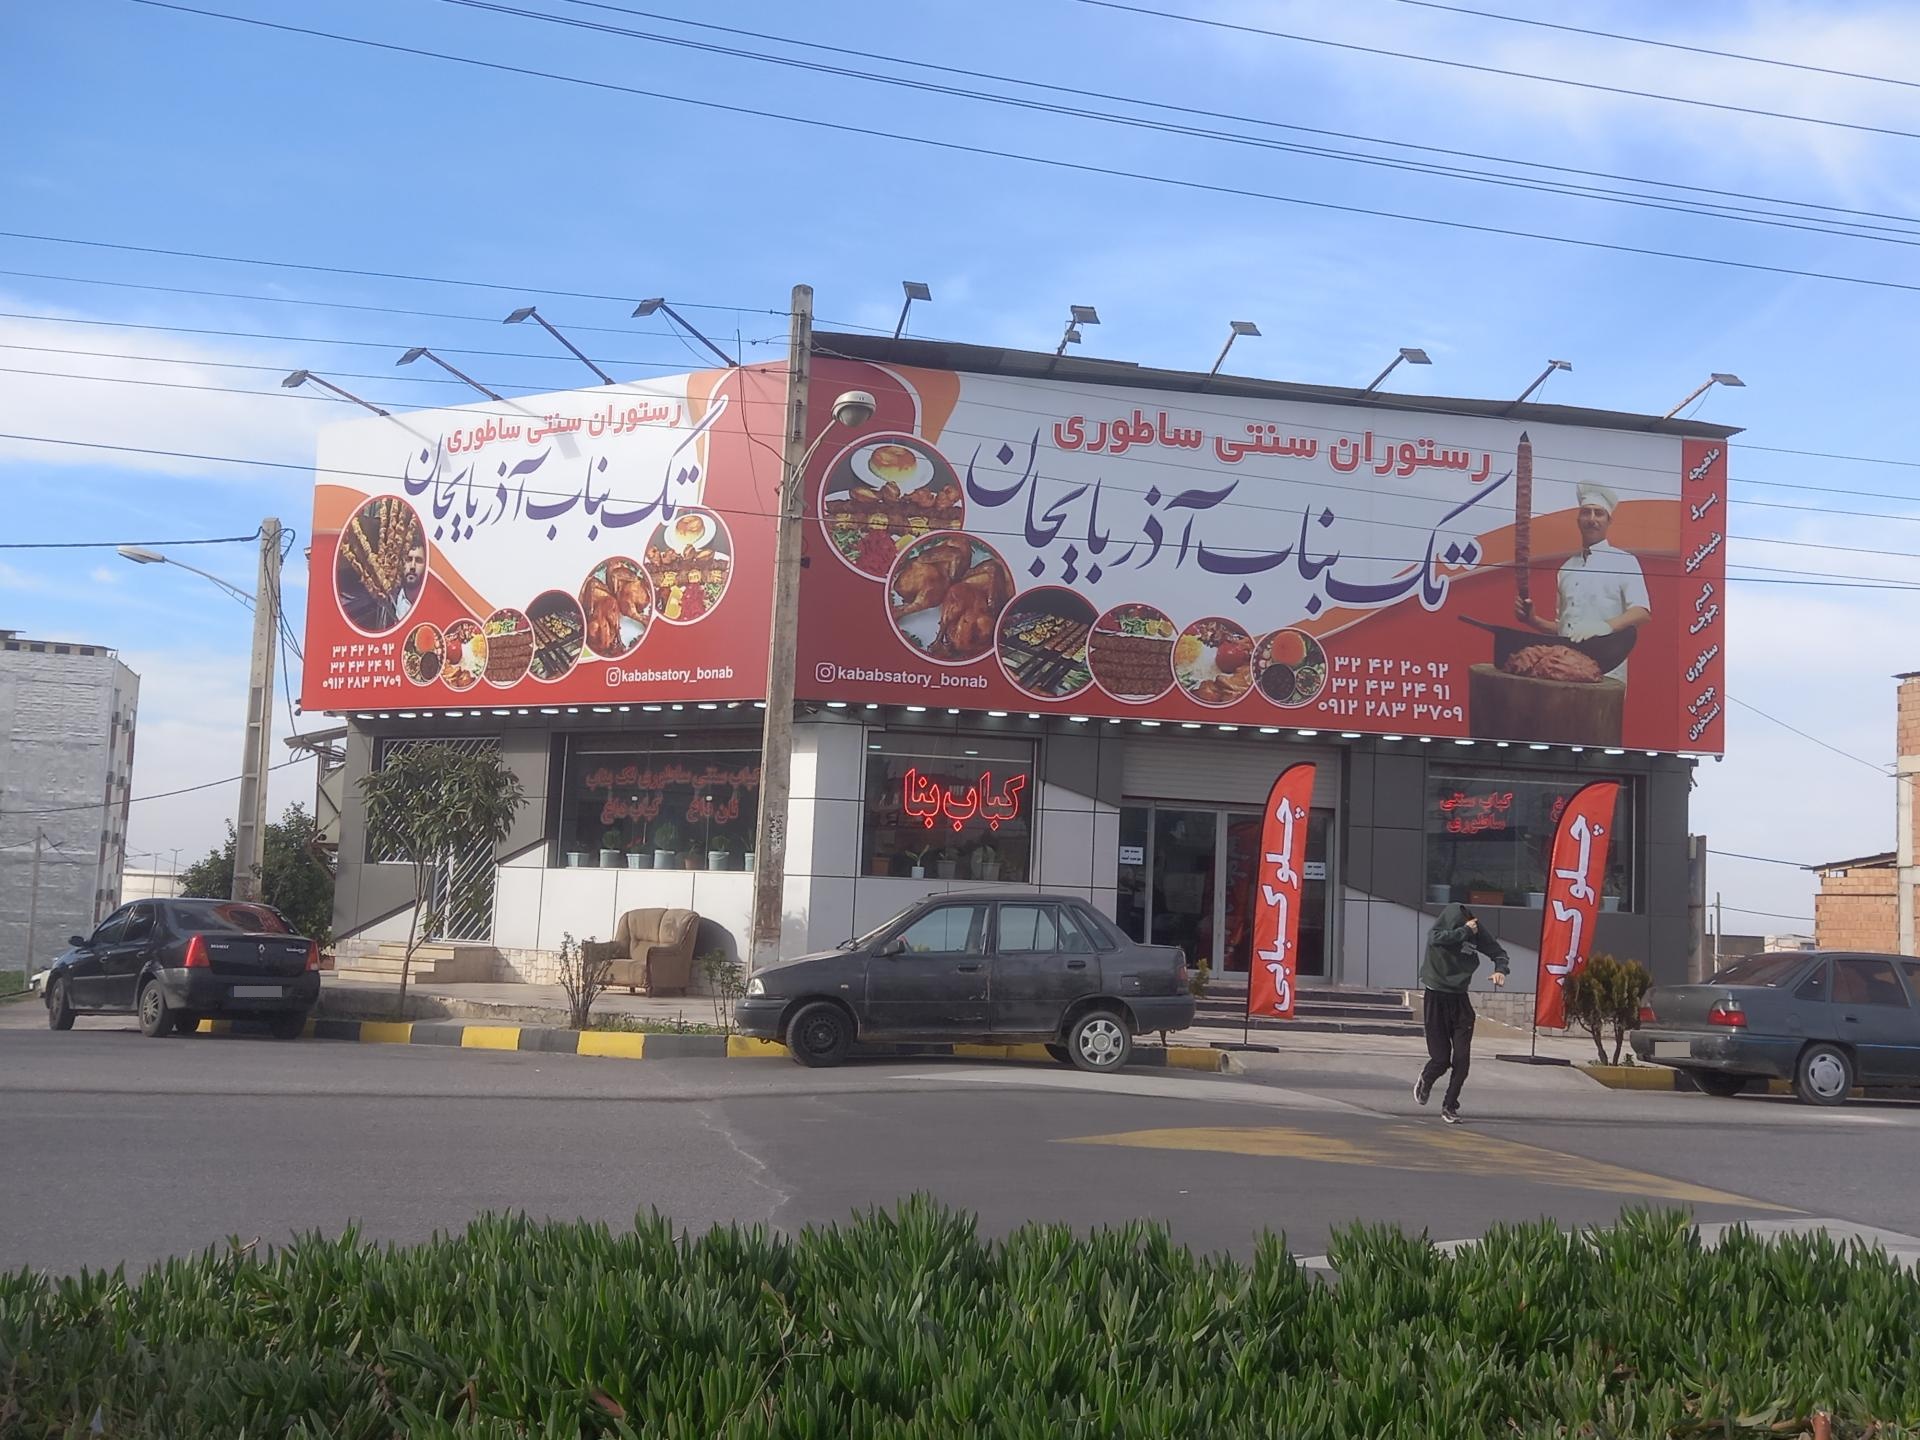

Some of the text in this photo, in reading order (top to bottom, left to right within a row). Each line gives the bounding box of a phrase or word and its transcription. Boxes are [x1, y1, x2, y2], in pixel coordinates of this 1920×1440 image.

[446, 402, 682, 454] رستوران سنتی ساطوری
[1052, 409, 1492, 483] رستوران سنتی ساطوری
[403, 397, 728, 542] تک بناب آذربایجان
[1689, 448, 1720, 481] ماهیچه
[966, 427, 1513, 614] تک بناب آذربایجان
[1691, 492, 1719, 521] برگ
[1685, 531, 1722, 573] شیشلیک
[1696, 583, 1714, 611] اکبر
[1689, 604, 1719, 634] جوجه
[332, 643, 395, 658] ۳۲ ۴۲ ۲۰ ۹۲
[1685, 644, 1719, 682] ساطوری
[330, 659, 395, 674] ۳۲ ۴۳ ۲۴ ۹۱
[621, 666, 733, 683] kababsatory_bonab
[837, 666, 988, 689] kababsatory_bonab
[1334, 656, 1449, 678] ۳۲ ۴۲ ۲۰ ۹۲
[322, 675, 401, 690] ۰۹۱۲ ۲۸۳ ۳۷۰۹
[1331, 677, 1450, 700] ۳۲ ۴۳ ۲۴ ۹۱
[1696, 686, 1715, 708] جوجه
[1318, 698, 1463, 722] ۰۹۱۲ ۲۸۳ ۳۷۰۹
[1689, 702, 1720, 741] استخوان
[942, 769, 1026, 832] کباب
[1256, 797, 1304, 1012] چلو کبابی
[1545, 814, 1604, 986] چلو کبا
